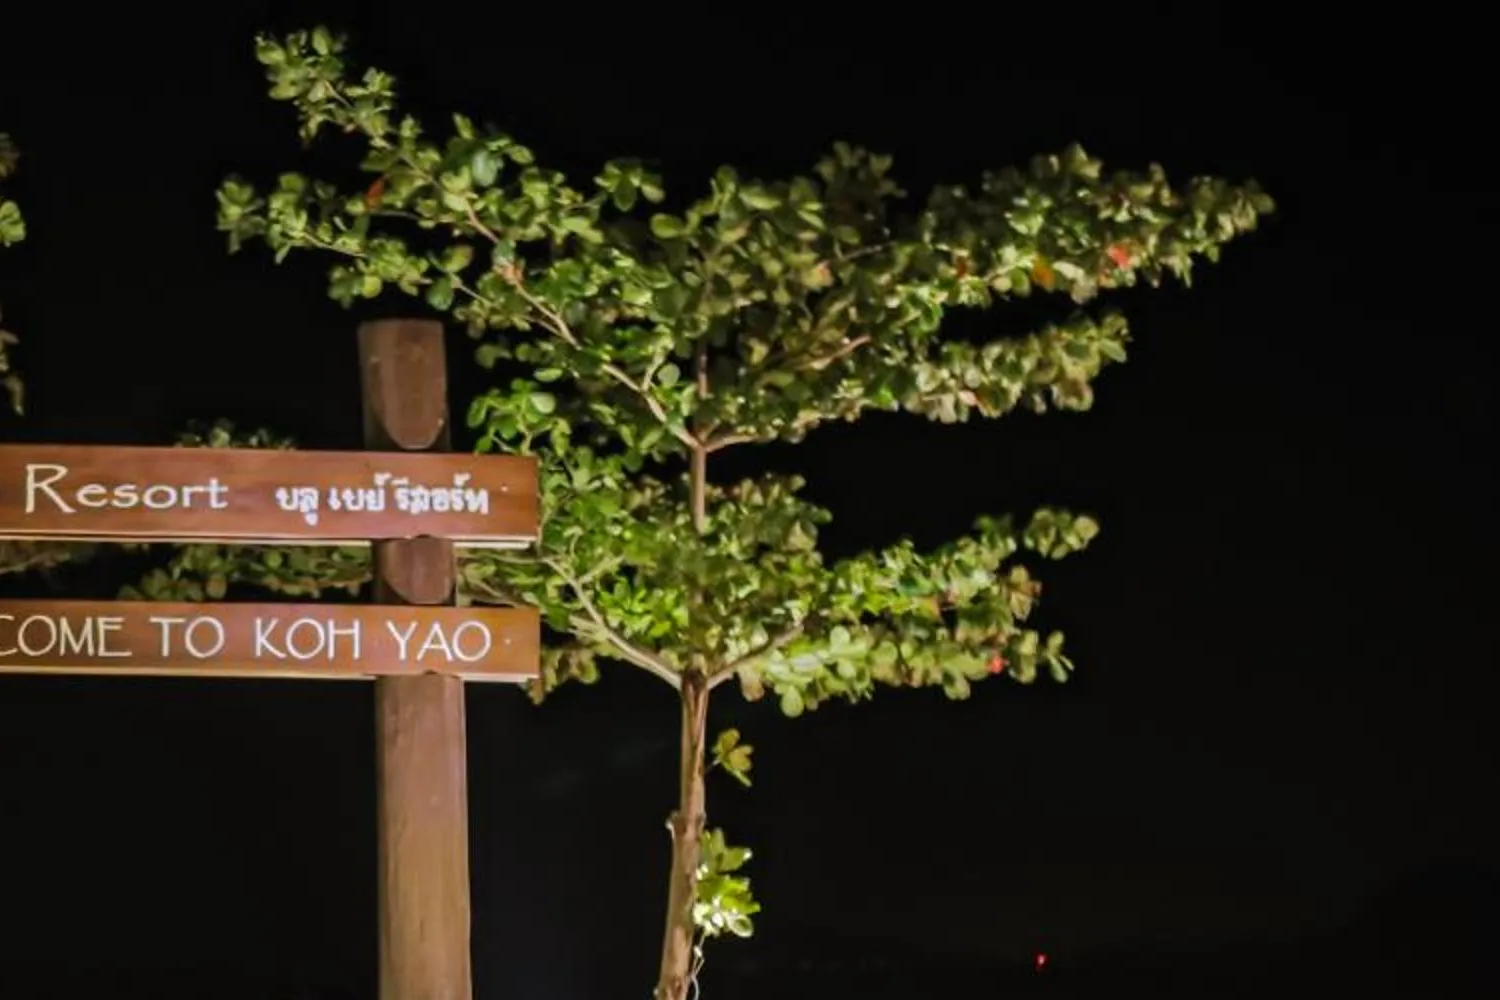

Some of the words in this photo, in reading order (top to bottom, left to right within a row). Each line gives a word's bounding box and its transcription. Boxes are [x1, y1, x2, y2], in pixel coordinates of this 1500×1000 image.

[25, 463, 230, 514] Resort
[149, 615, 226, 659] TO
[253, 616, 362, 661] KOH
[385, 619, 492, 663] YAO
